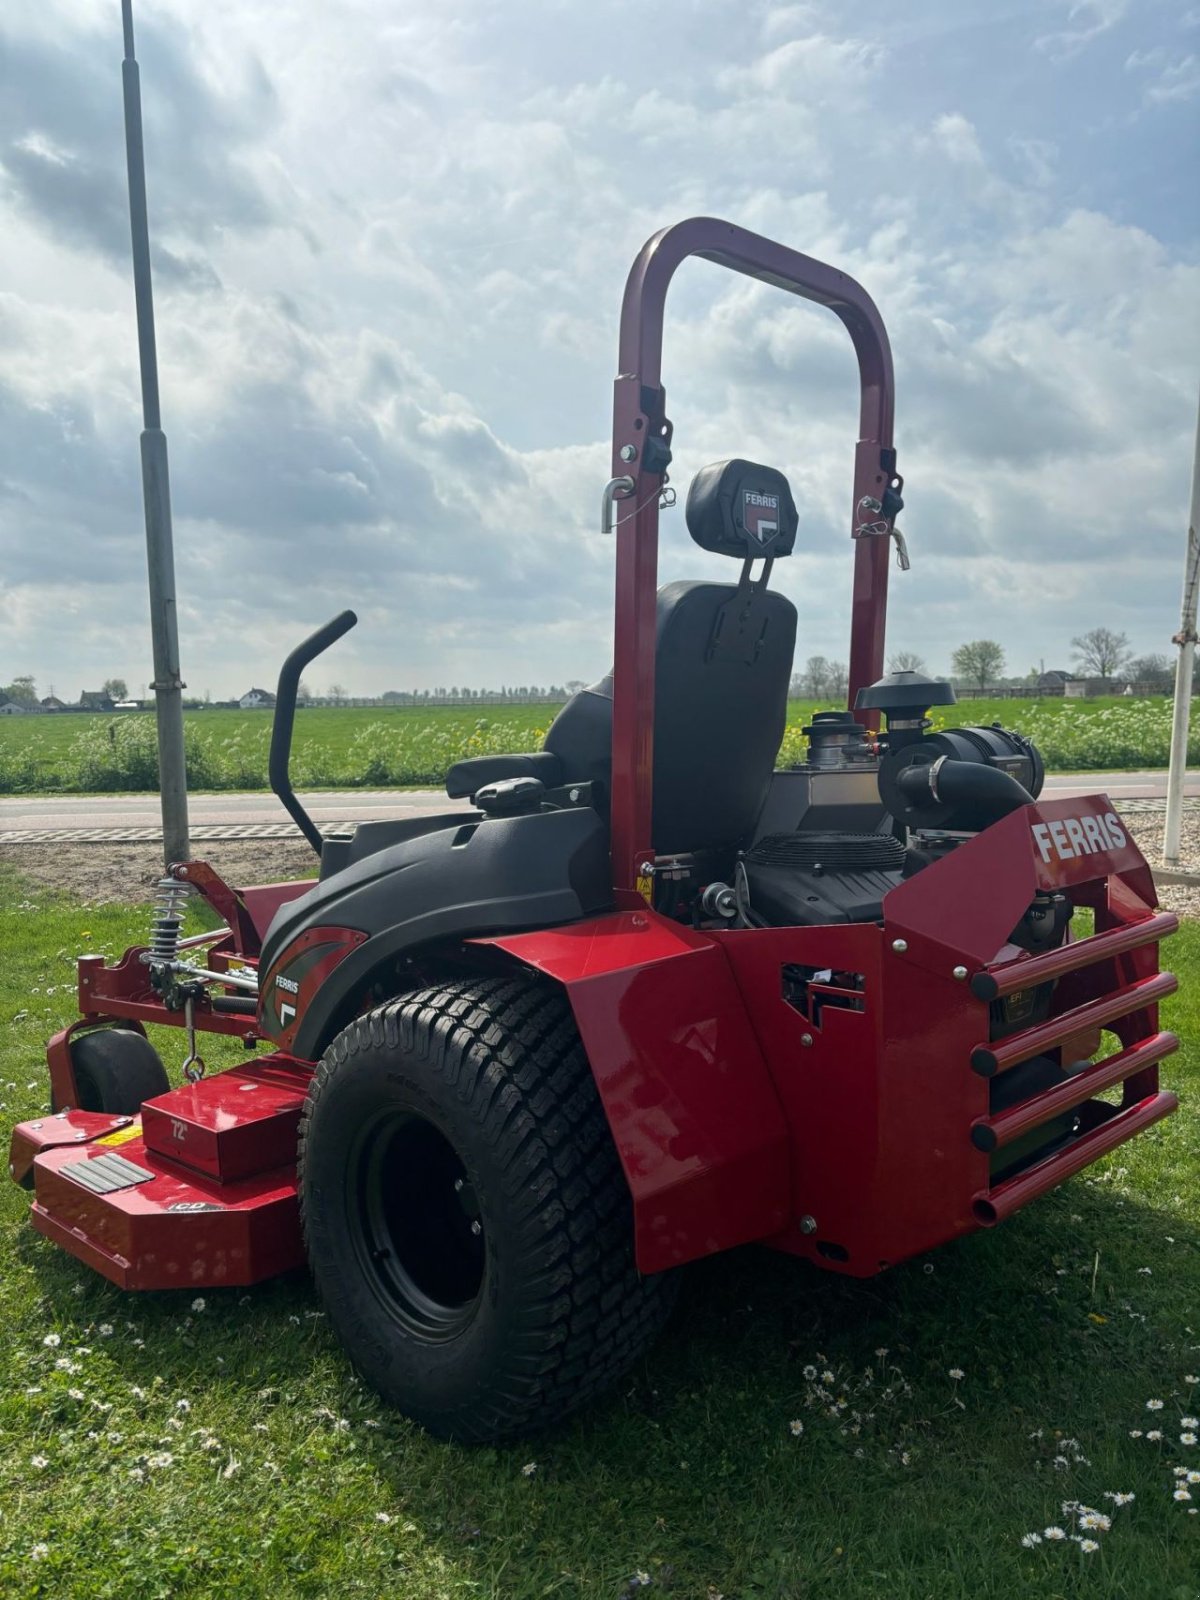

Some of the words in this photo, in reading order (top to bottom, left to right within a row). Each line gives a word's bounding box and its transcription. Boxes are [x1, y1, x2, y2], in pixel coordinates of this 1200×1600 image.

[745, 493, 777, 509] FERRIS
[1031, 812, 1127, 864] FERRIS
[275, 975, 299, 994] FERRIS
